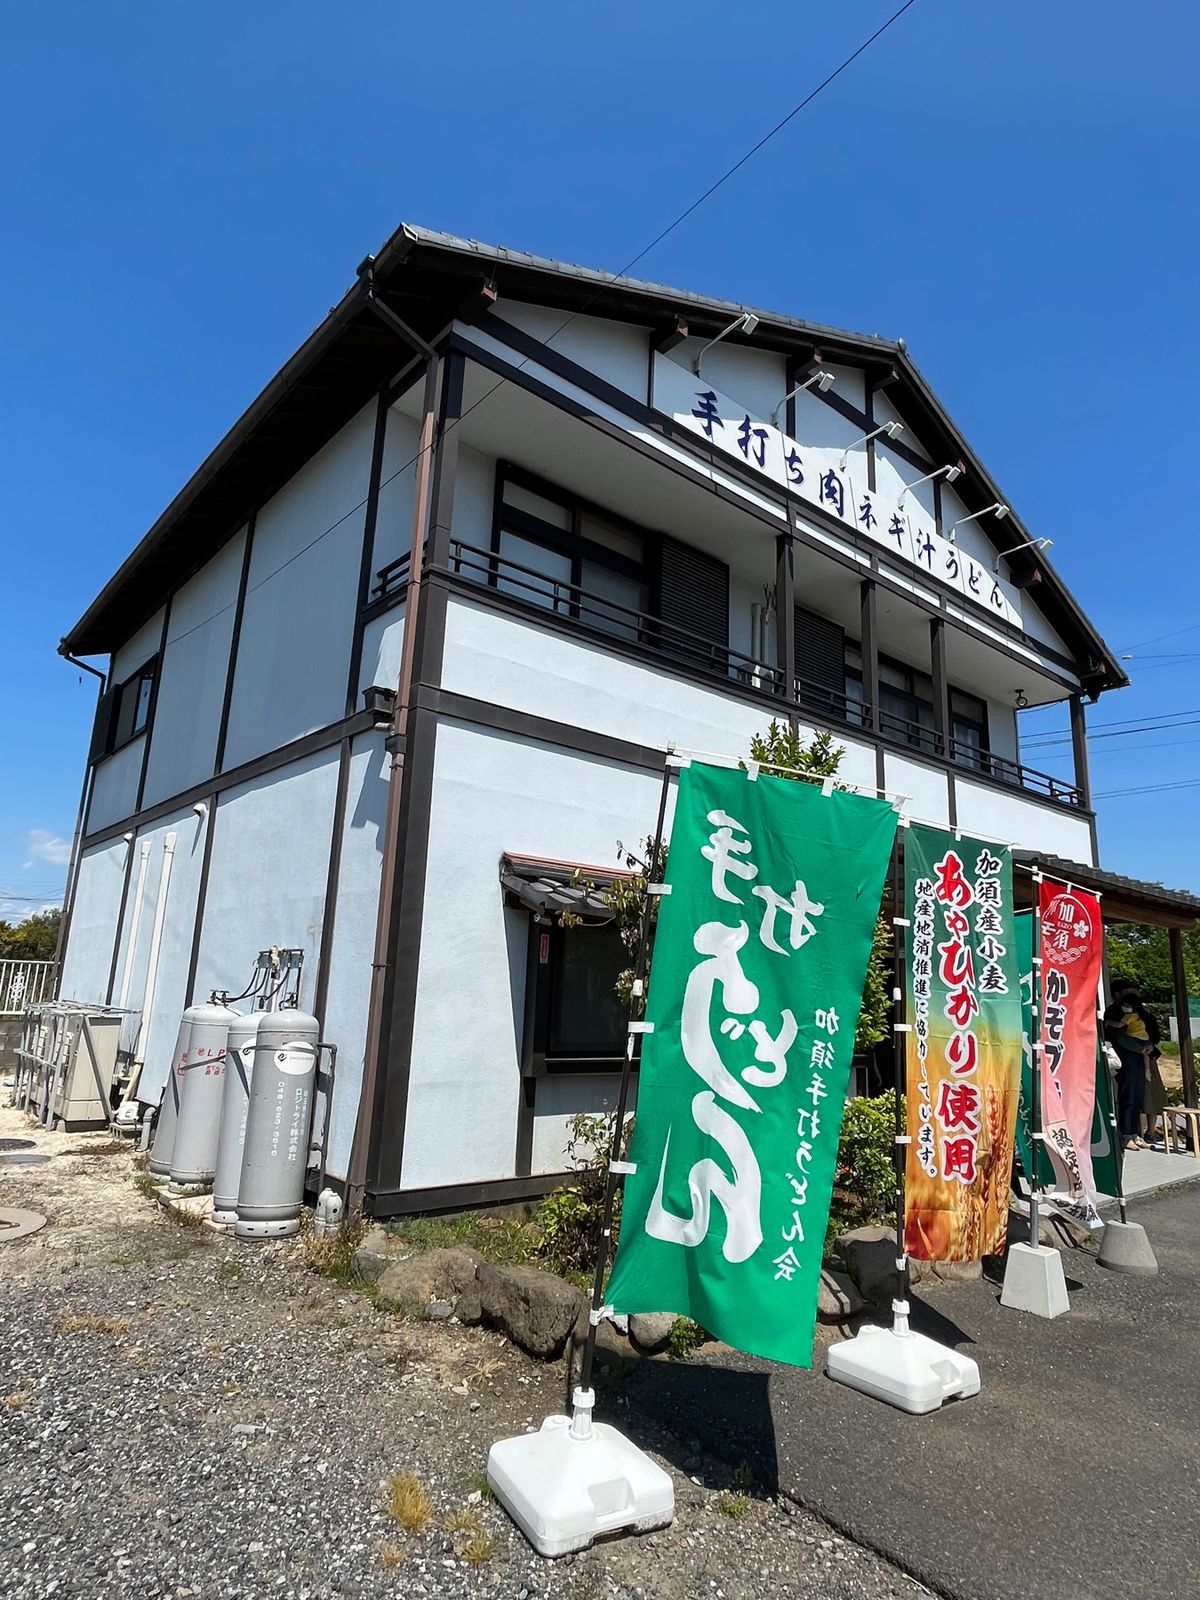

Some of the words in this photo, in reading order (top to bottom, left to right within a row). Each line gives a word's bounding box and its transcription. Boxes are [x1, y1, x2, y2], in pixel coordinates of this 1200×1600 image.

[691, 390, 1004, 608] 手打ち肉ネギ汁うどん
[935, 853, 979, 1181] あやひかり使用
[977, 850, 1006, 992] 加須産小麦
